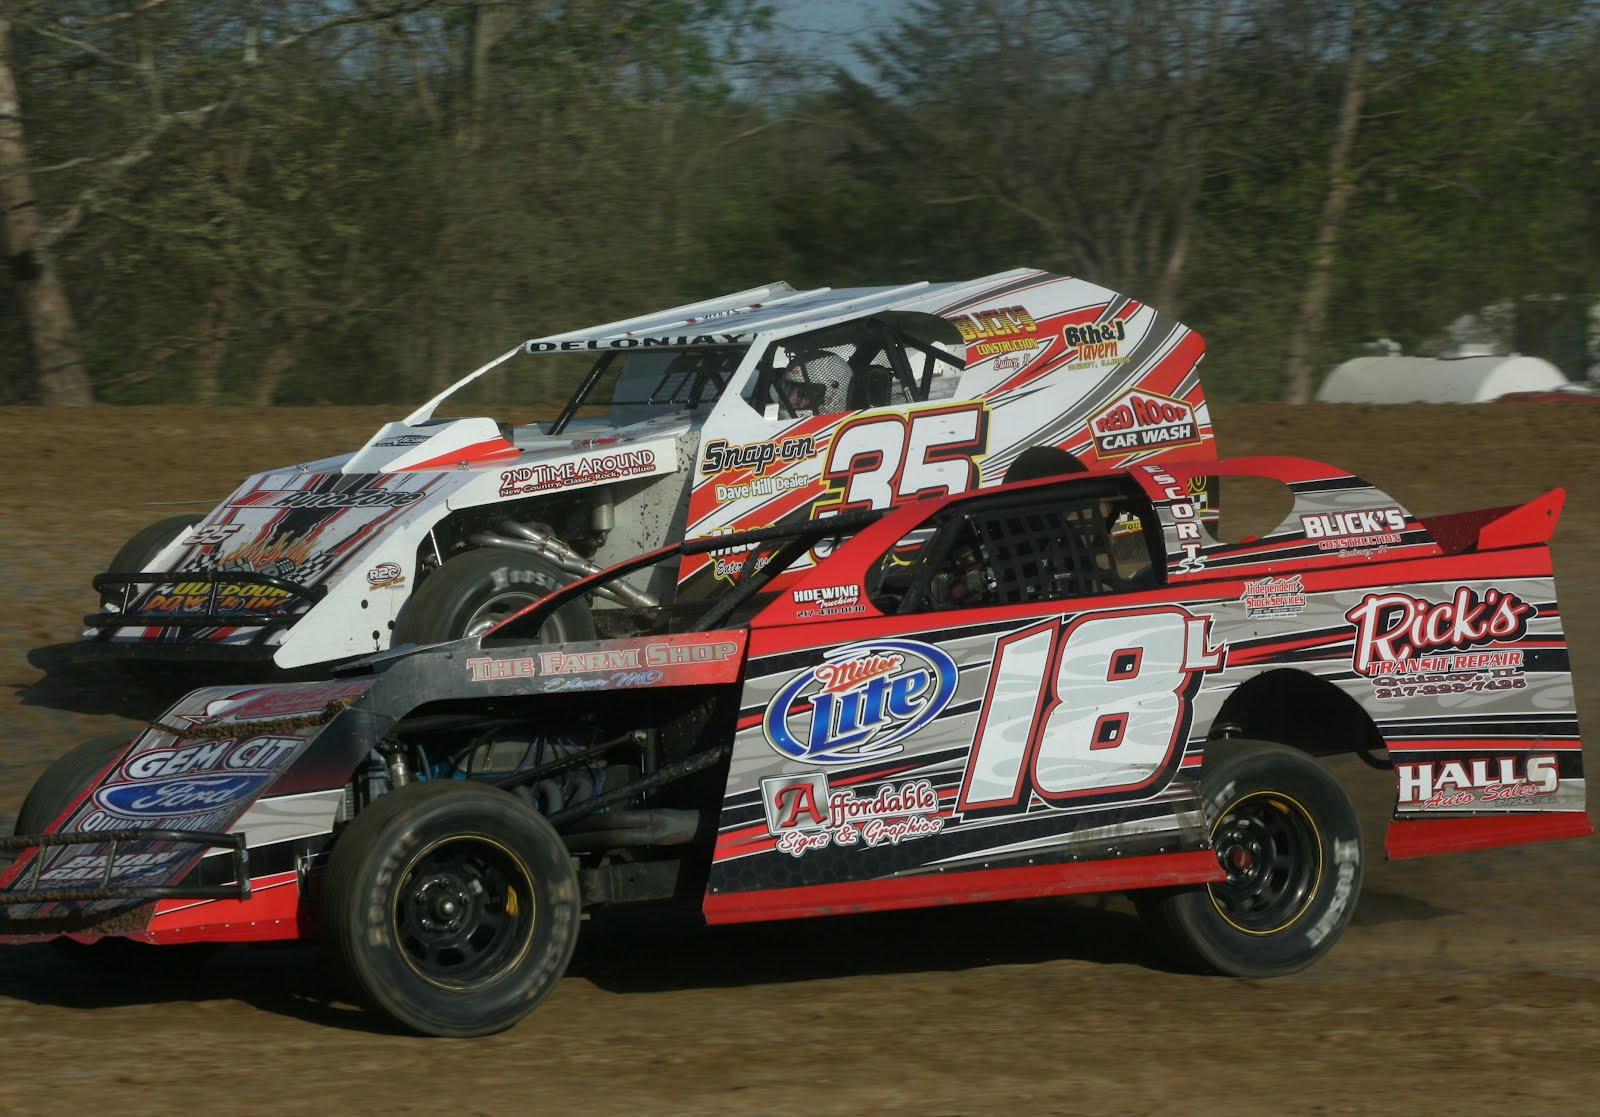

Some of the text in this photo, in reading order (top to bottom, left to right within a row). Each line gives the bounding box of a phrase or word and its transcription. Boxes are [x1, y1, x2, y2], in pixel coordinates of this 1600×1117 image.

[976, 338, 1039, 356] CONSTRUCTION
[1077, 341, 1118, 361] Tavern
[1097, 395, 1187, 432] RED ROOF
[1102, 425, 1192, 450] CAR WASH
[501, 450, 655, 489] 2ND TIME AROUND
[701, 435, 817, 475] Snap-on
[500, 487, 521, 496] New
[564, 475, 592, 486] Classic
[594, 471, 619, 481] Rock,
[633, 464, 656, 474] Blues
[716, 474, 808, 501] Dave Hill Dealer
[1302, 509, 1406, 539] BLICK'S
[1319, 534, 1401, 550] CONSTRUCTION
[794, 584, 860, 602] HOEWING
[816, 597, 858, 609] Trucking
[1246, 595, 1304, 608] Shock Services
[1247, 581, 1297, 595] Independent
[1350, 587, 1528, 673] Rick's
[467, 642, 738, 681] THE FARM SHOP
[816, 654, 905, 693] Miller
[1368, 651, 1524, 676] TRANSIT REPAIR
[1490, 667, 1526, 679] IL
[800, 669, 931, 756] Lite
[124, 739, 235, 780] GEM
[131, 777, 250, 810] Ford
[1397, 754, 1559, 804] HALLS
[774, 782, 937, 829] Affordable
[1421, 782, 1540, 810] Auto Sales
[781, 817, 942, 853] Signs & Graphics
